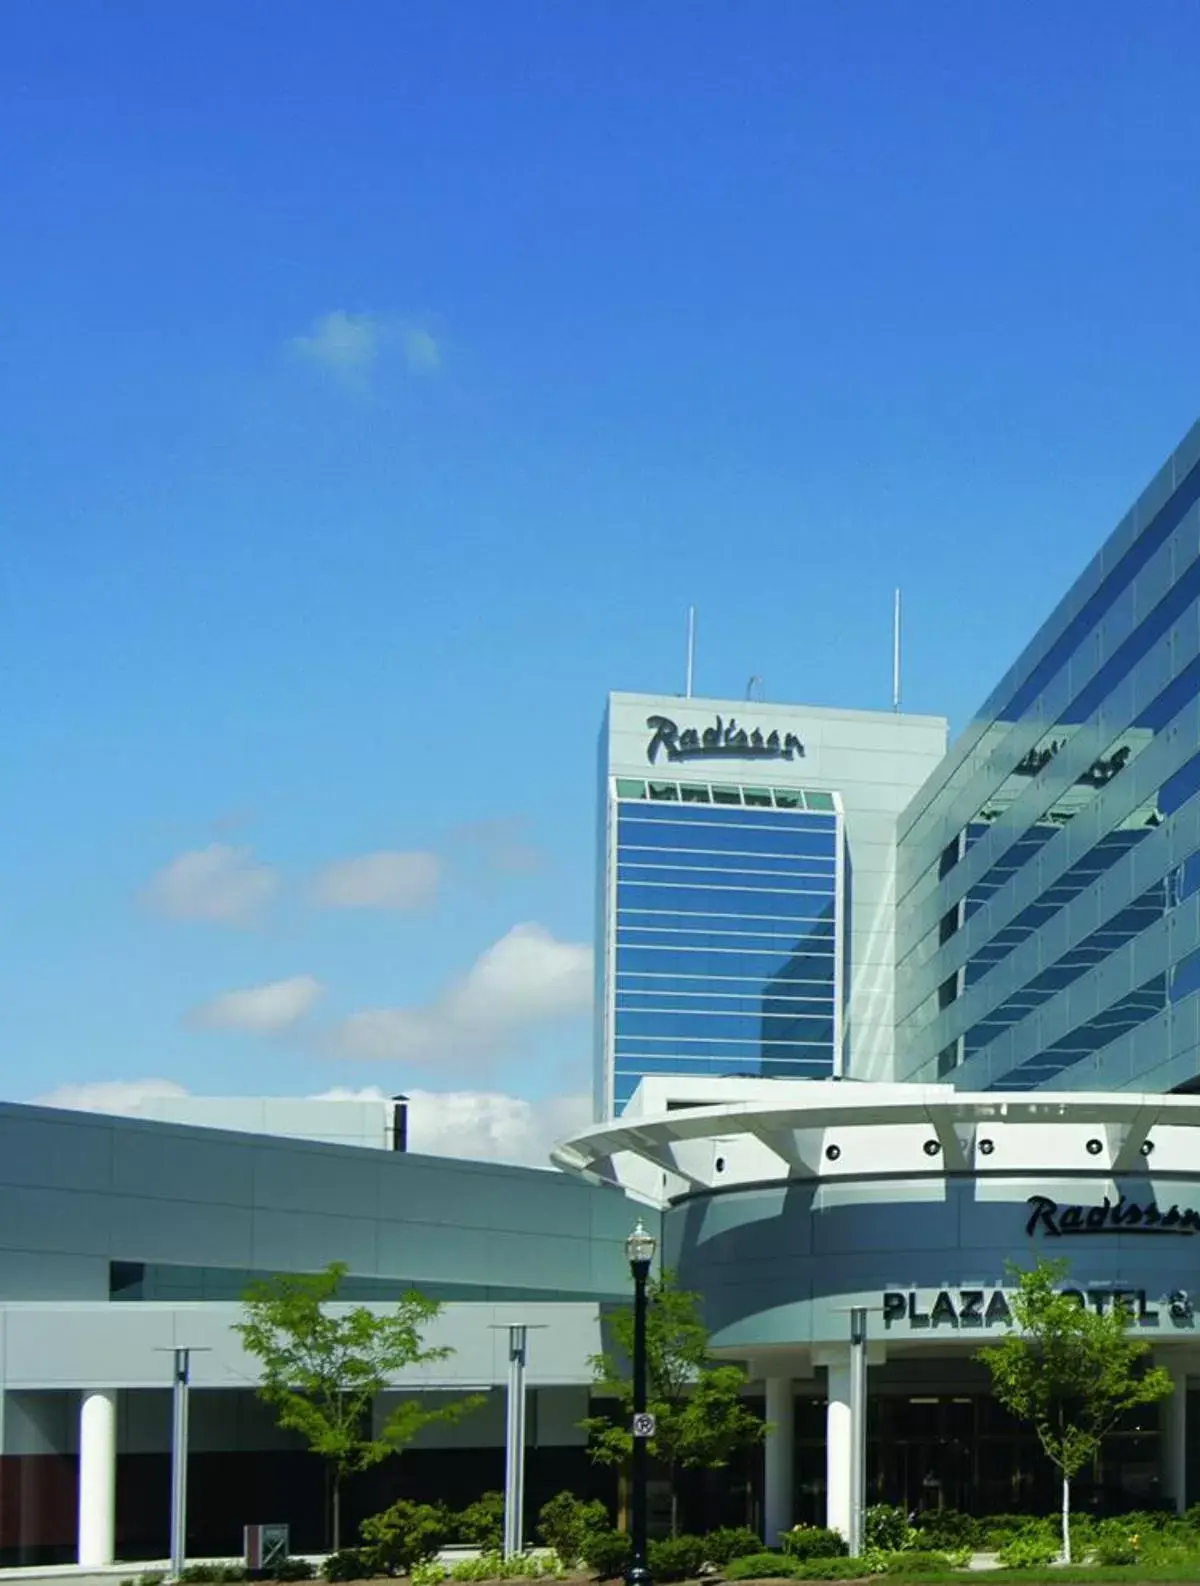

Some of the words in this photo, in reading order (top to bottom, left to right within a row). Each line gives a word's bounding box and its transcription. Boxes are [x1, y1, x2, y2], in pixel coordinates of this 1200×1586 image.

[646, 714, 805, 765] Radisson
[883, 1290, 1014, 1320] PLAZA
[1034, 1289, 1159, 1319] OTEL
[1170, 1289, 1194, 1318] &
